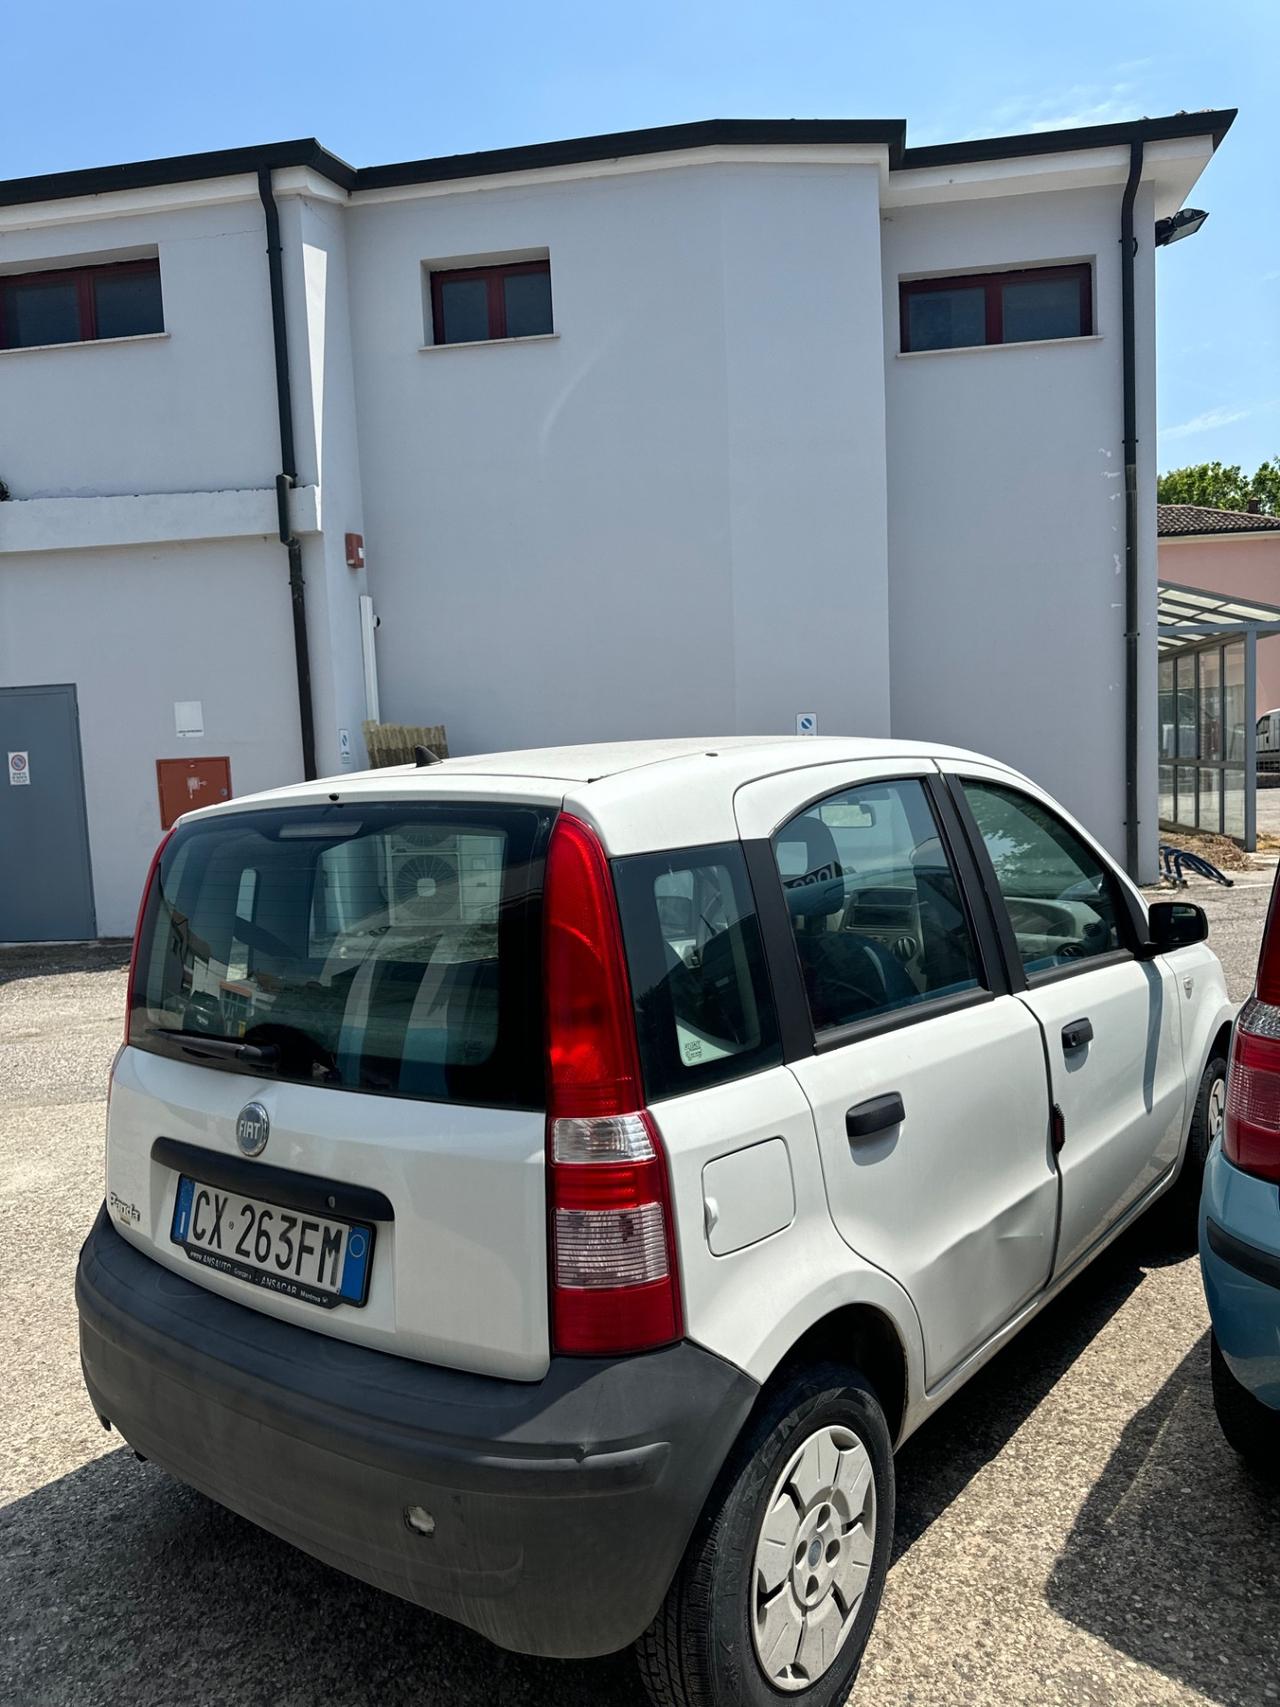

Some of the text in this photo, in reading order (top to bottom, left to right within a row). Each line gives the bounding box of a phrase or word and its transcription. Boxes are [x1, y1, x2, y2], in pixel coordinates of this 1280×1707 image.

[240, 1119, 260, 1140] FIAT
[109, 1191, 141, 1222] Panda
[192, 1190, 228, 1250] CX
[235, 1203, 343, 1288] 263FM
